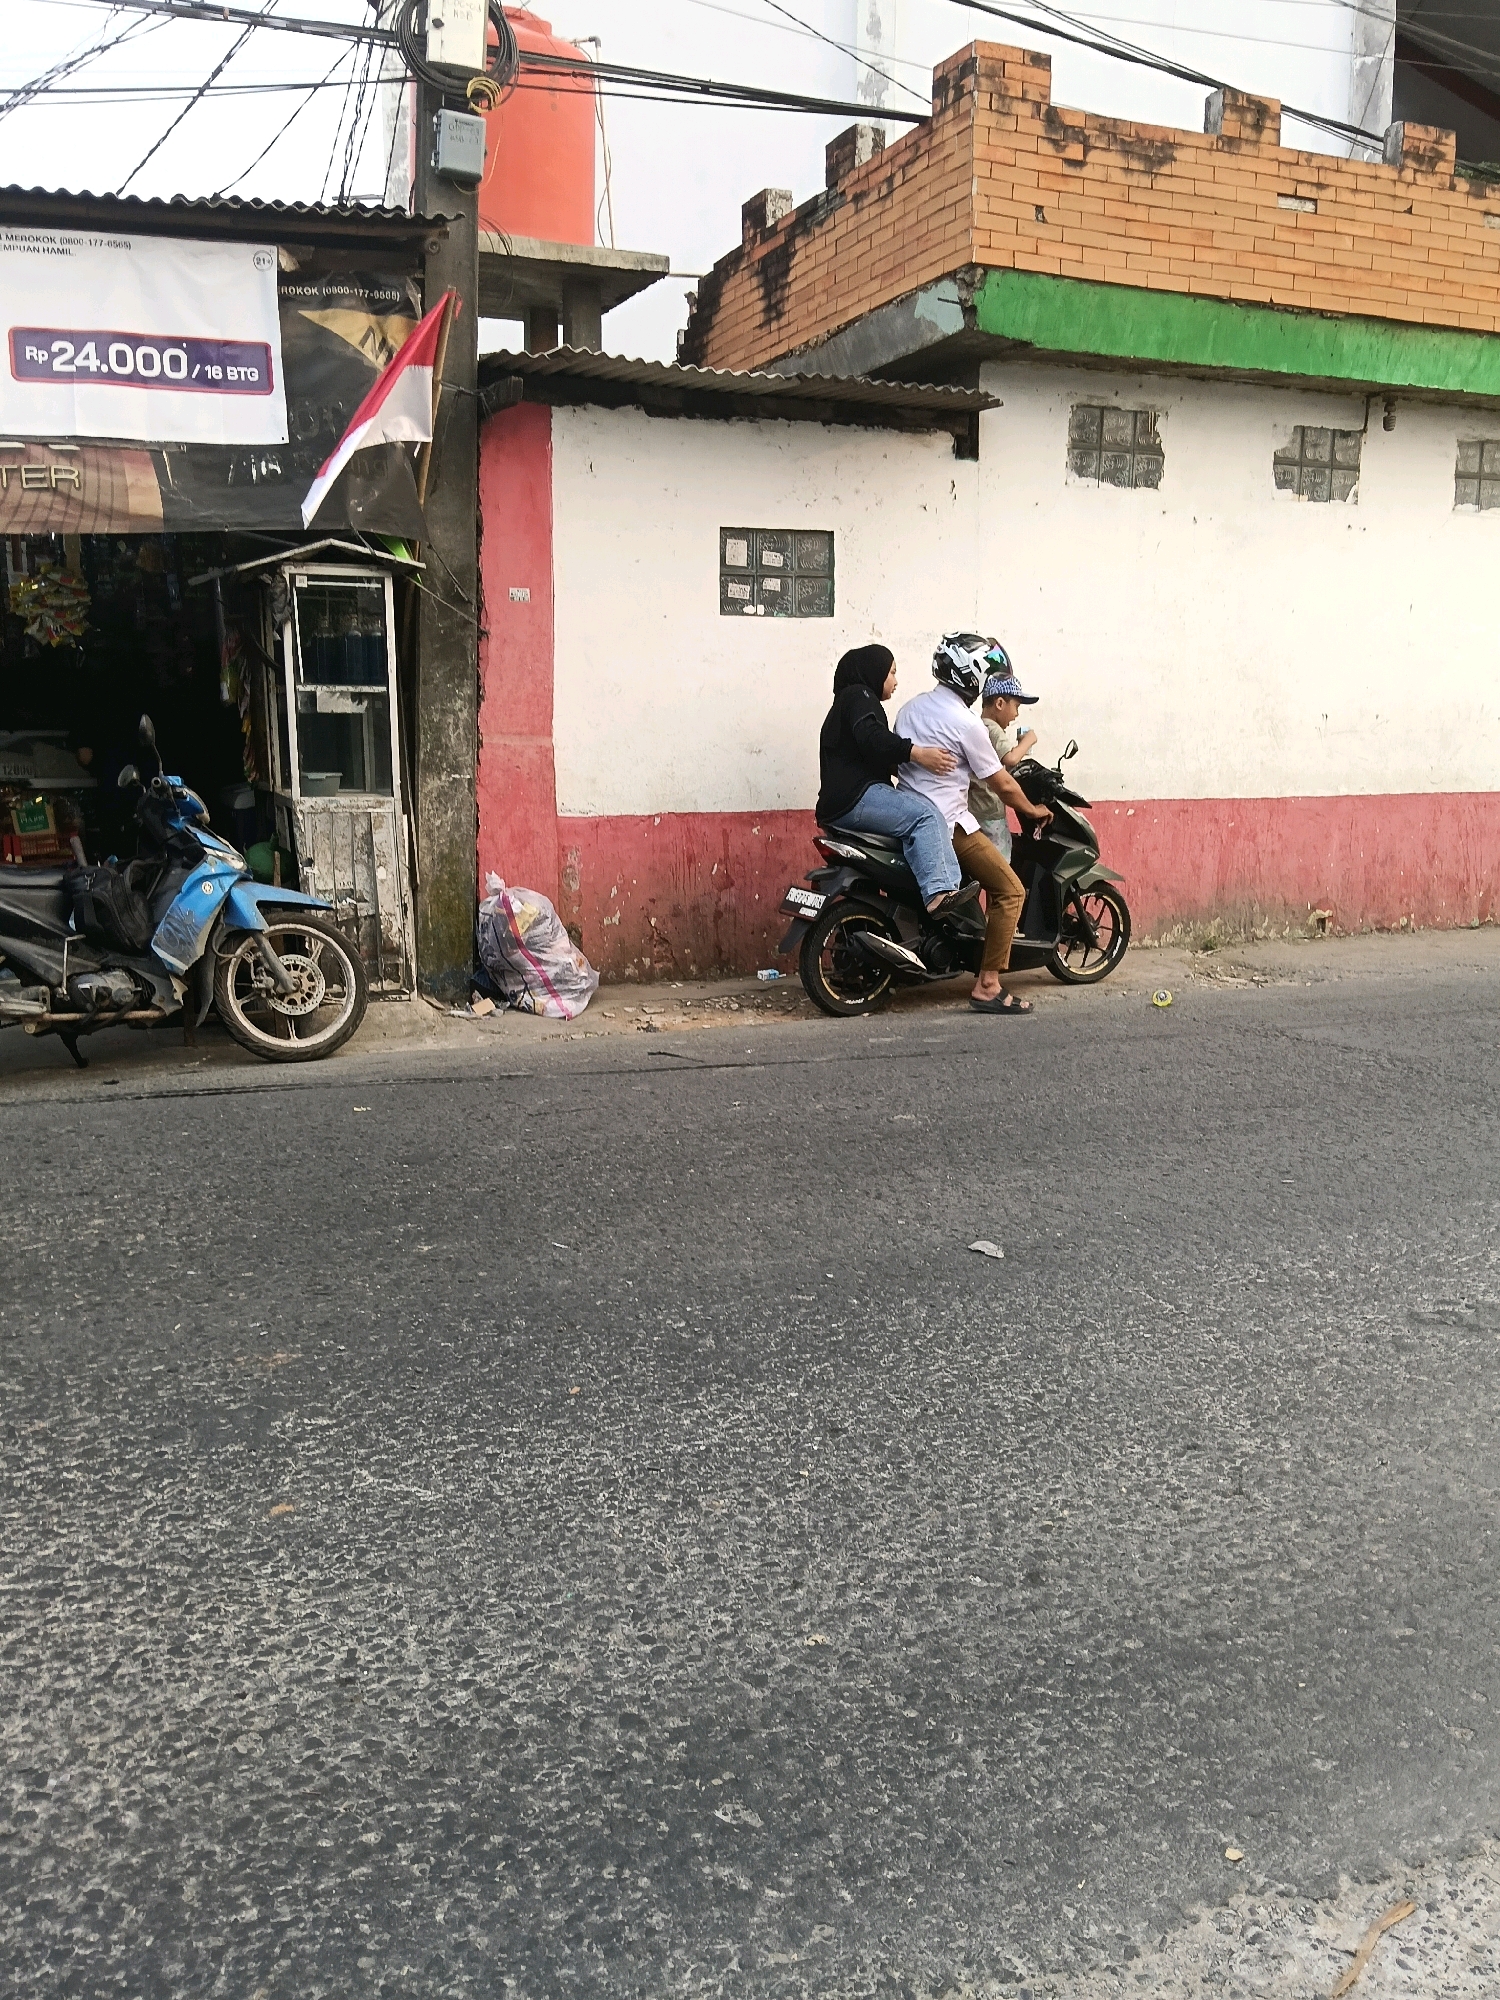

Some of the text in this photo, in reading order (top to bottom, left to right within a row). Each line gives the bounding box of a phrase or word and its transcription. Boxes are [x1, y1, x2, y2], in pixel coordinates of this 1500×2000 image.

[5, 233, 57, 245] MEROKOK
[25, 345, 49, 365] Rp
[51, 340, 188, 380] 24.000
[204, 364, 223, 380] 16
[226, 365, 260, 382] BTG
